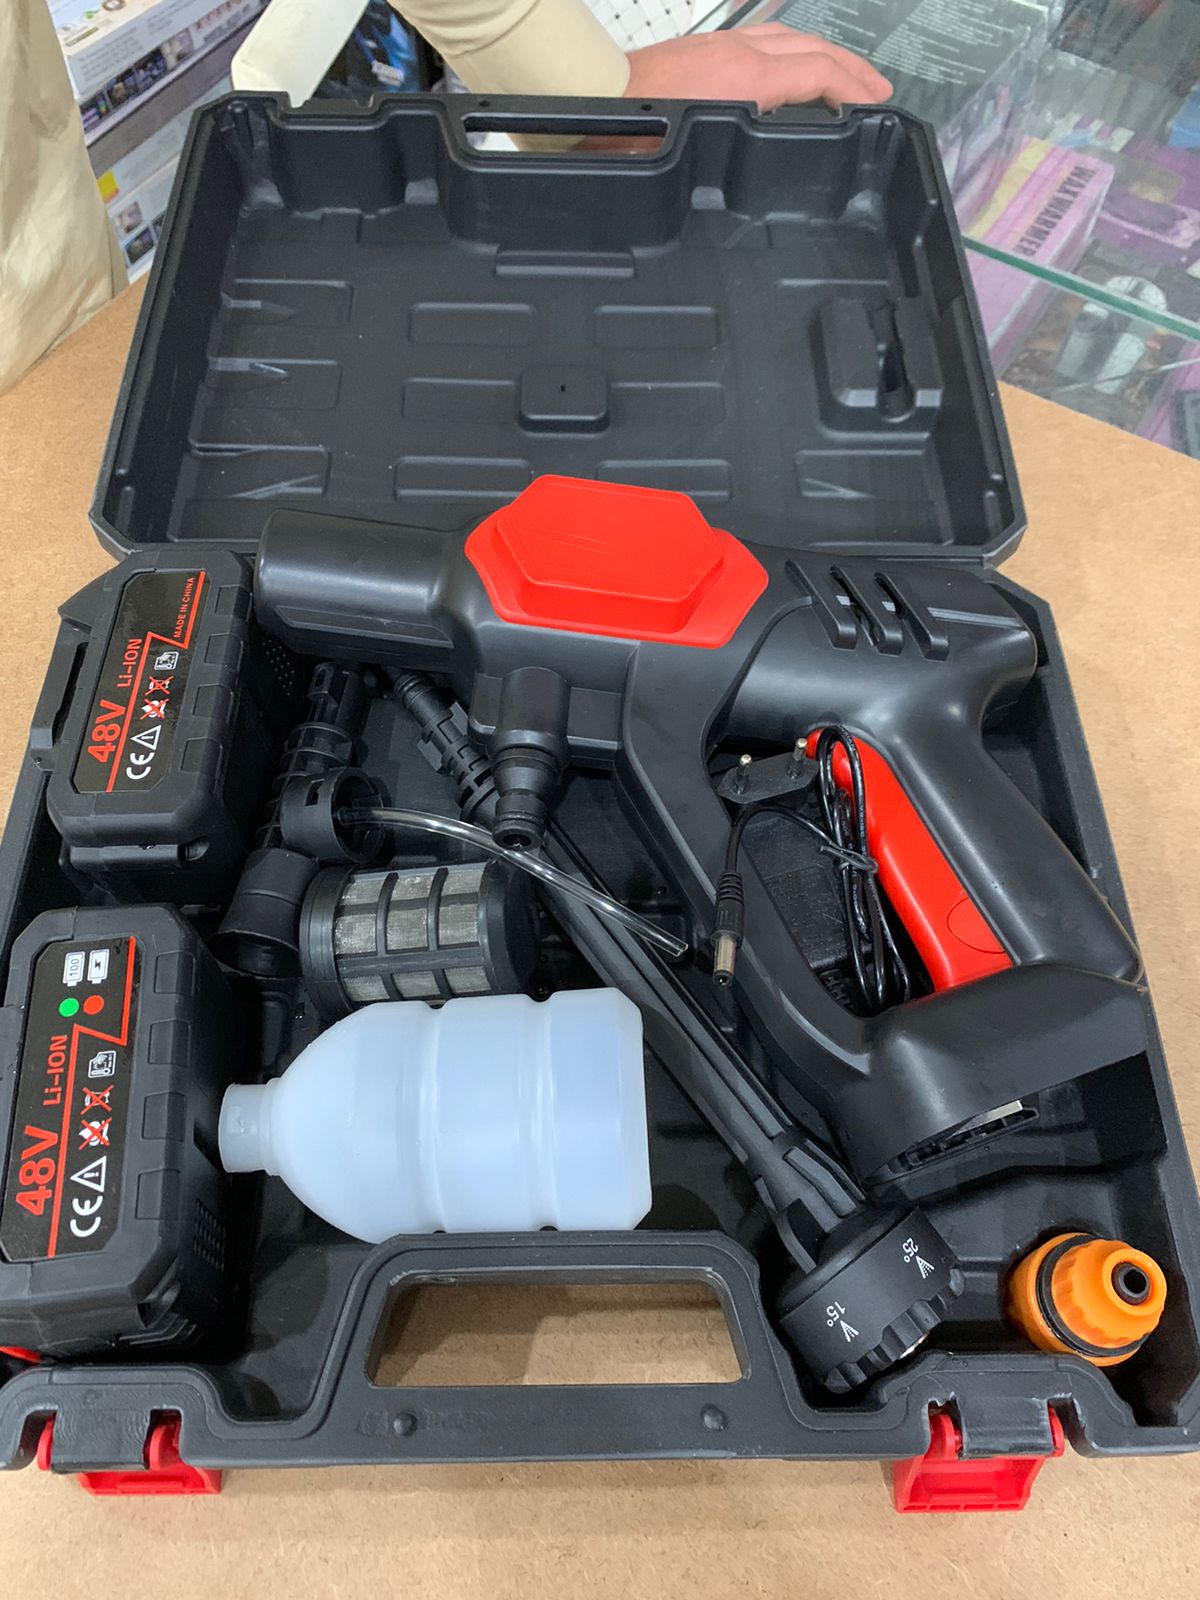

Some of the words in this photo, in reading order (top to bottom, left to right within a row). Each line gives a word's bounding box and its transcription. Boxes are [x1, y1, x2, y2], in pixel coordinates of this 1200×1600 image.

[1057, 165, 1097, 199] WAX
[1013, 196, 1074, 257] WARMER
[182, 577, 194, 603] CHINA
[179, 603, 189, 613] IN
[173, 614, 186, 639] MADE
[87, 700, 126, 763] 48V
[117, 638, 143, 689] Li-ION
[69, 958, 80, 976] 100
[16, 1125, 58, 1216] 48V
[43, 1036, 69, 1107] Li-ION
